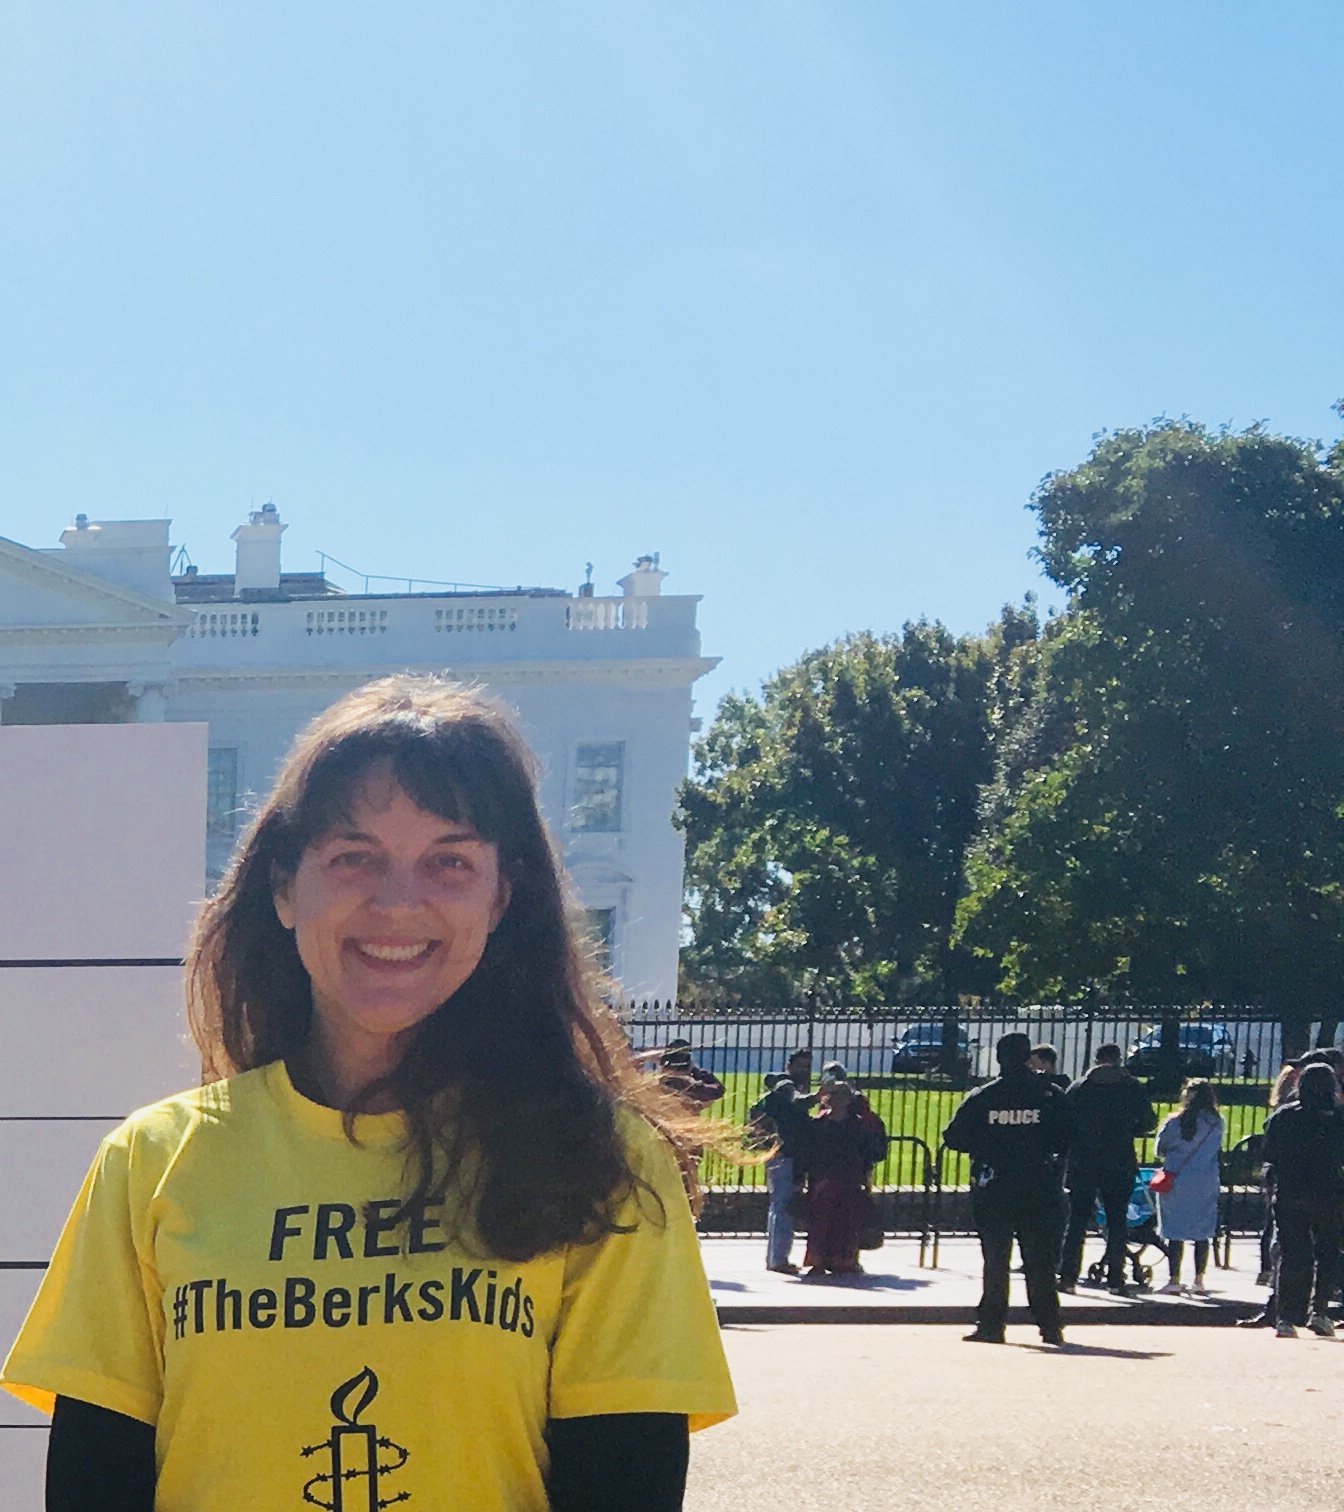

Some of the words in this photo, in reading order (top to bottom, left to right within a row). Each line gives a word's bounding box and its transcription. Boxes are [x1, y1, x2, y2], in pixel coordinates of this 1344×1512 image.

[988, 1109, 1041, 1125] POLICE
[268, 1198, 448, 1261] FREE
[173, 1267, 535, 1340] #TheBerksKids
